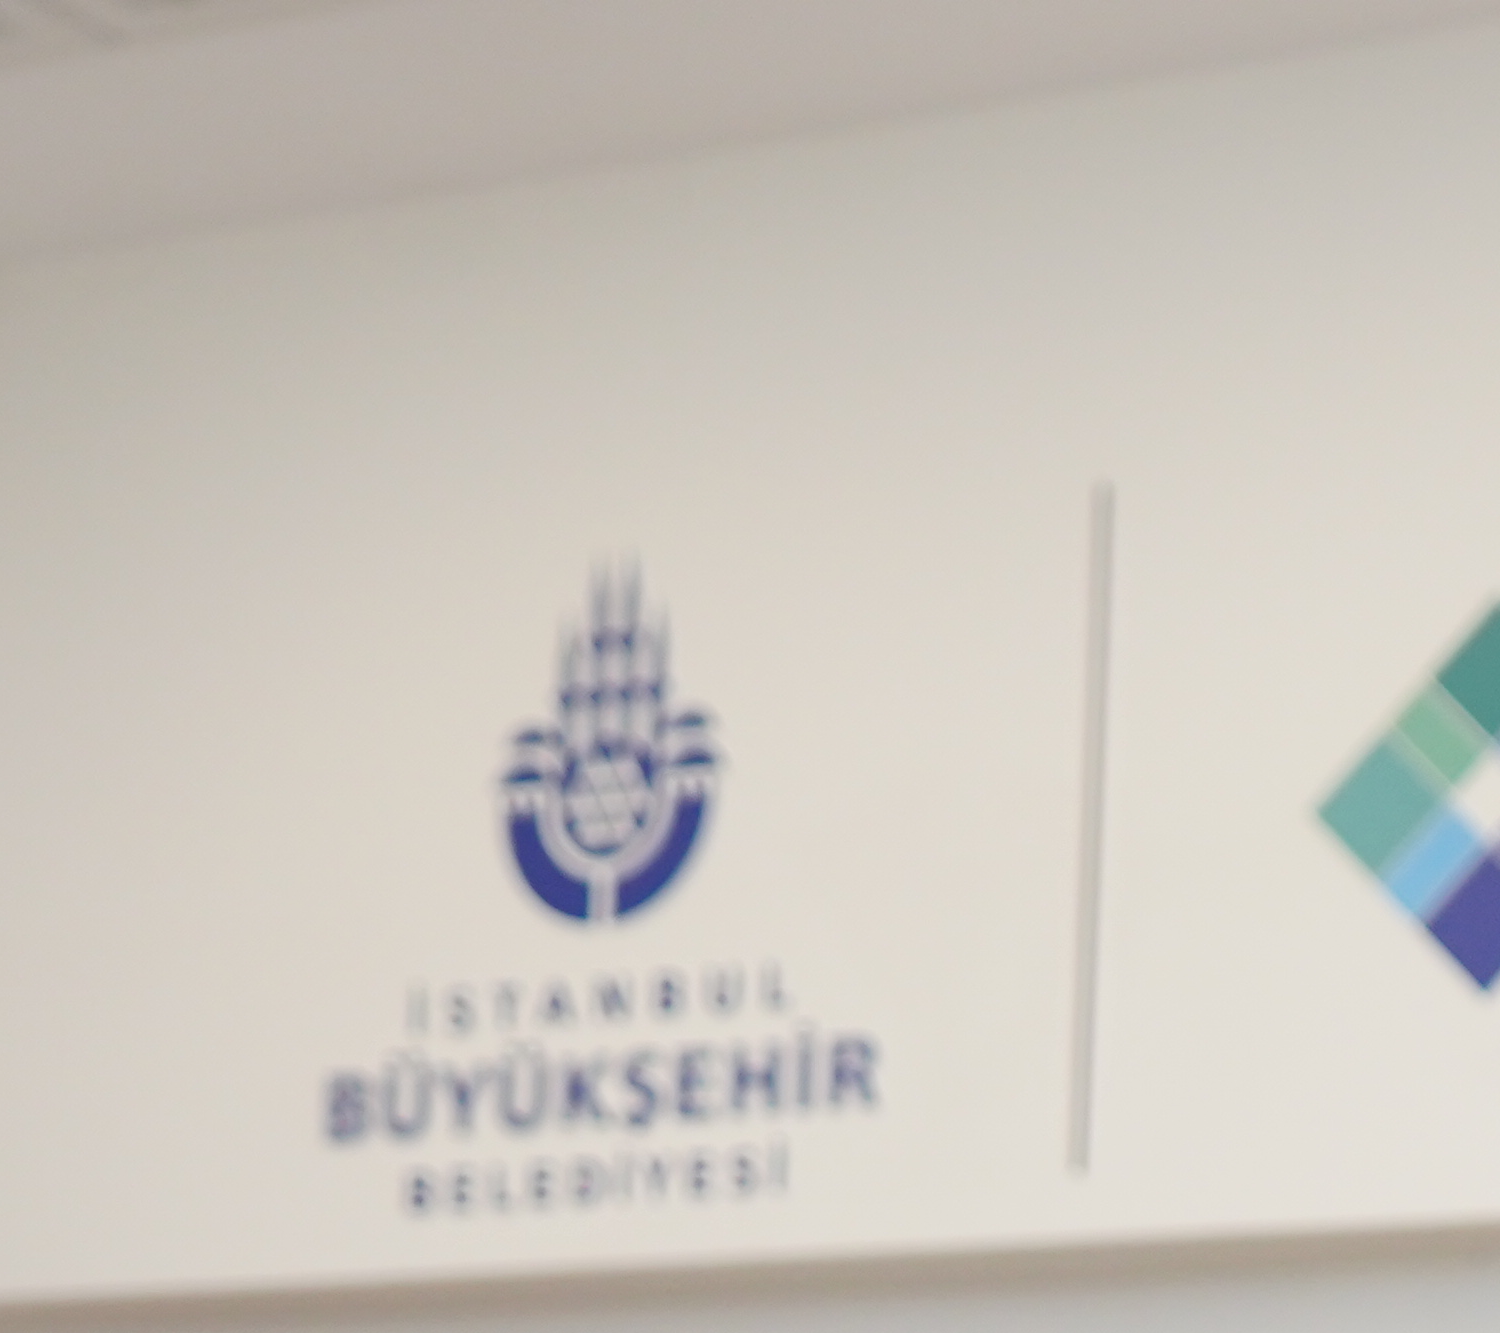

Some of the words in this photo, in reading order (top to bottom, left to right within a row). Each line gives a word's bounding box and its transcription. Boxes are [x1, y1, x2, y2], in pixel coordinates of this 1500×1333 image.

[407, 960, 791, 1036] İSTANBUL
[324, 1022, 879, 1143] BÜYÜKŞEHİR
[404, 1132, 790, 1213] BELEDİYESİ
